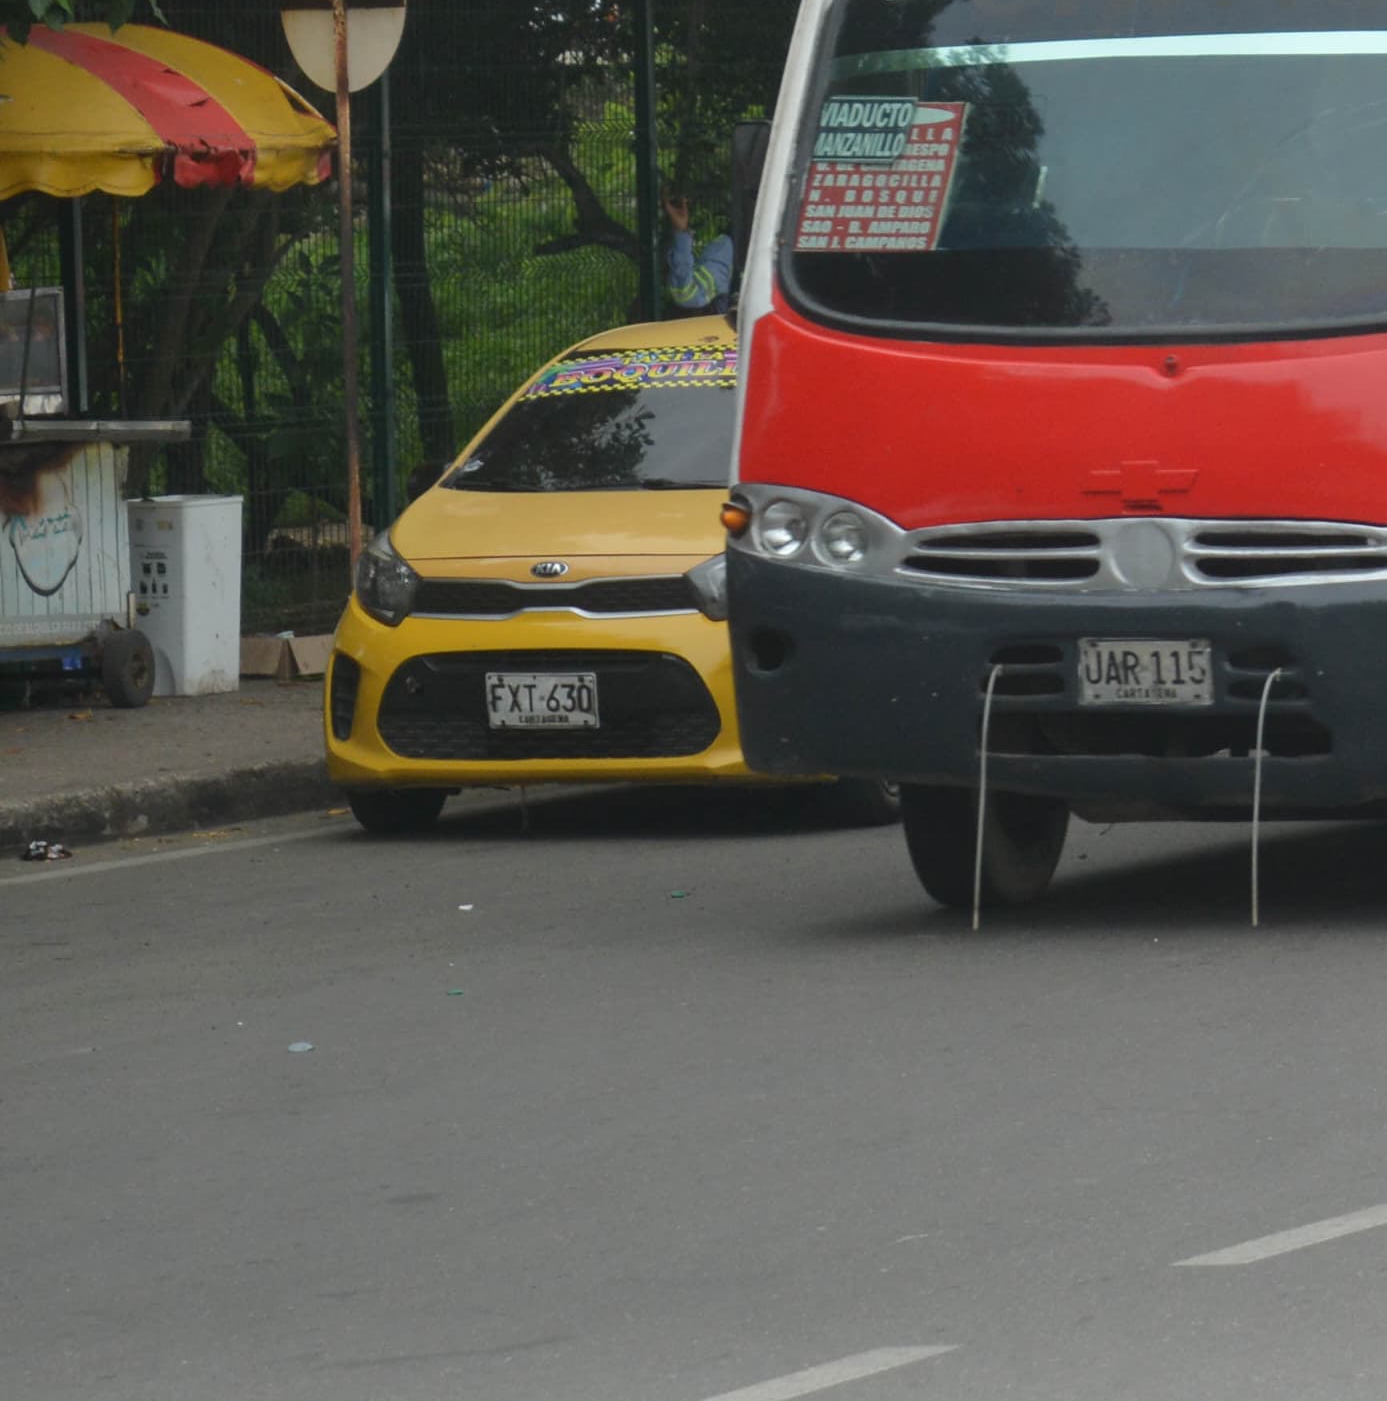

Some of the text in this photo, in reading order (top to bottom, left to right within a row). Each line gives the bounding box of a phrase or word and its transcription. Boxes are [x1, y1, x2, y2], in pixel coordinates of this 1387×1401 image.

[819, 103, 914, 127] VIADUCTO
[811, 174, 942, 187] ZARAGOCILLA
[844, 190, 939, 203] BOSQUE
[805, 205, 934, 218] SAN JUAN DE DIOS
[867, 221, 931, 234] AMPARO
[797, 236, 829, 248] SAN
[535, 562, 564, 575] KIA
